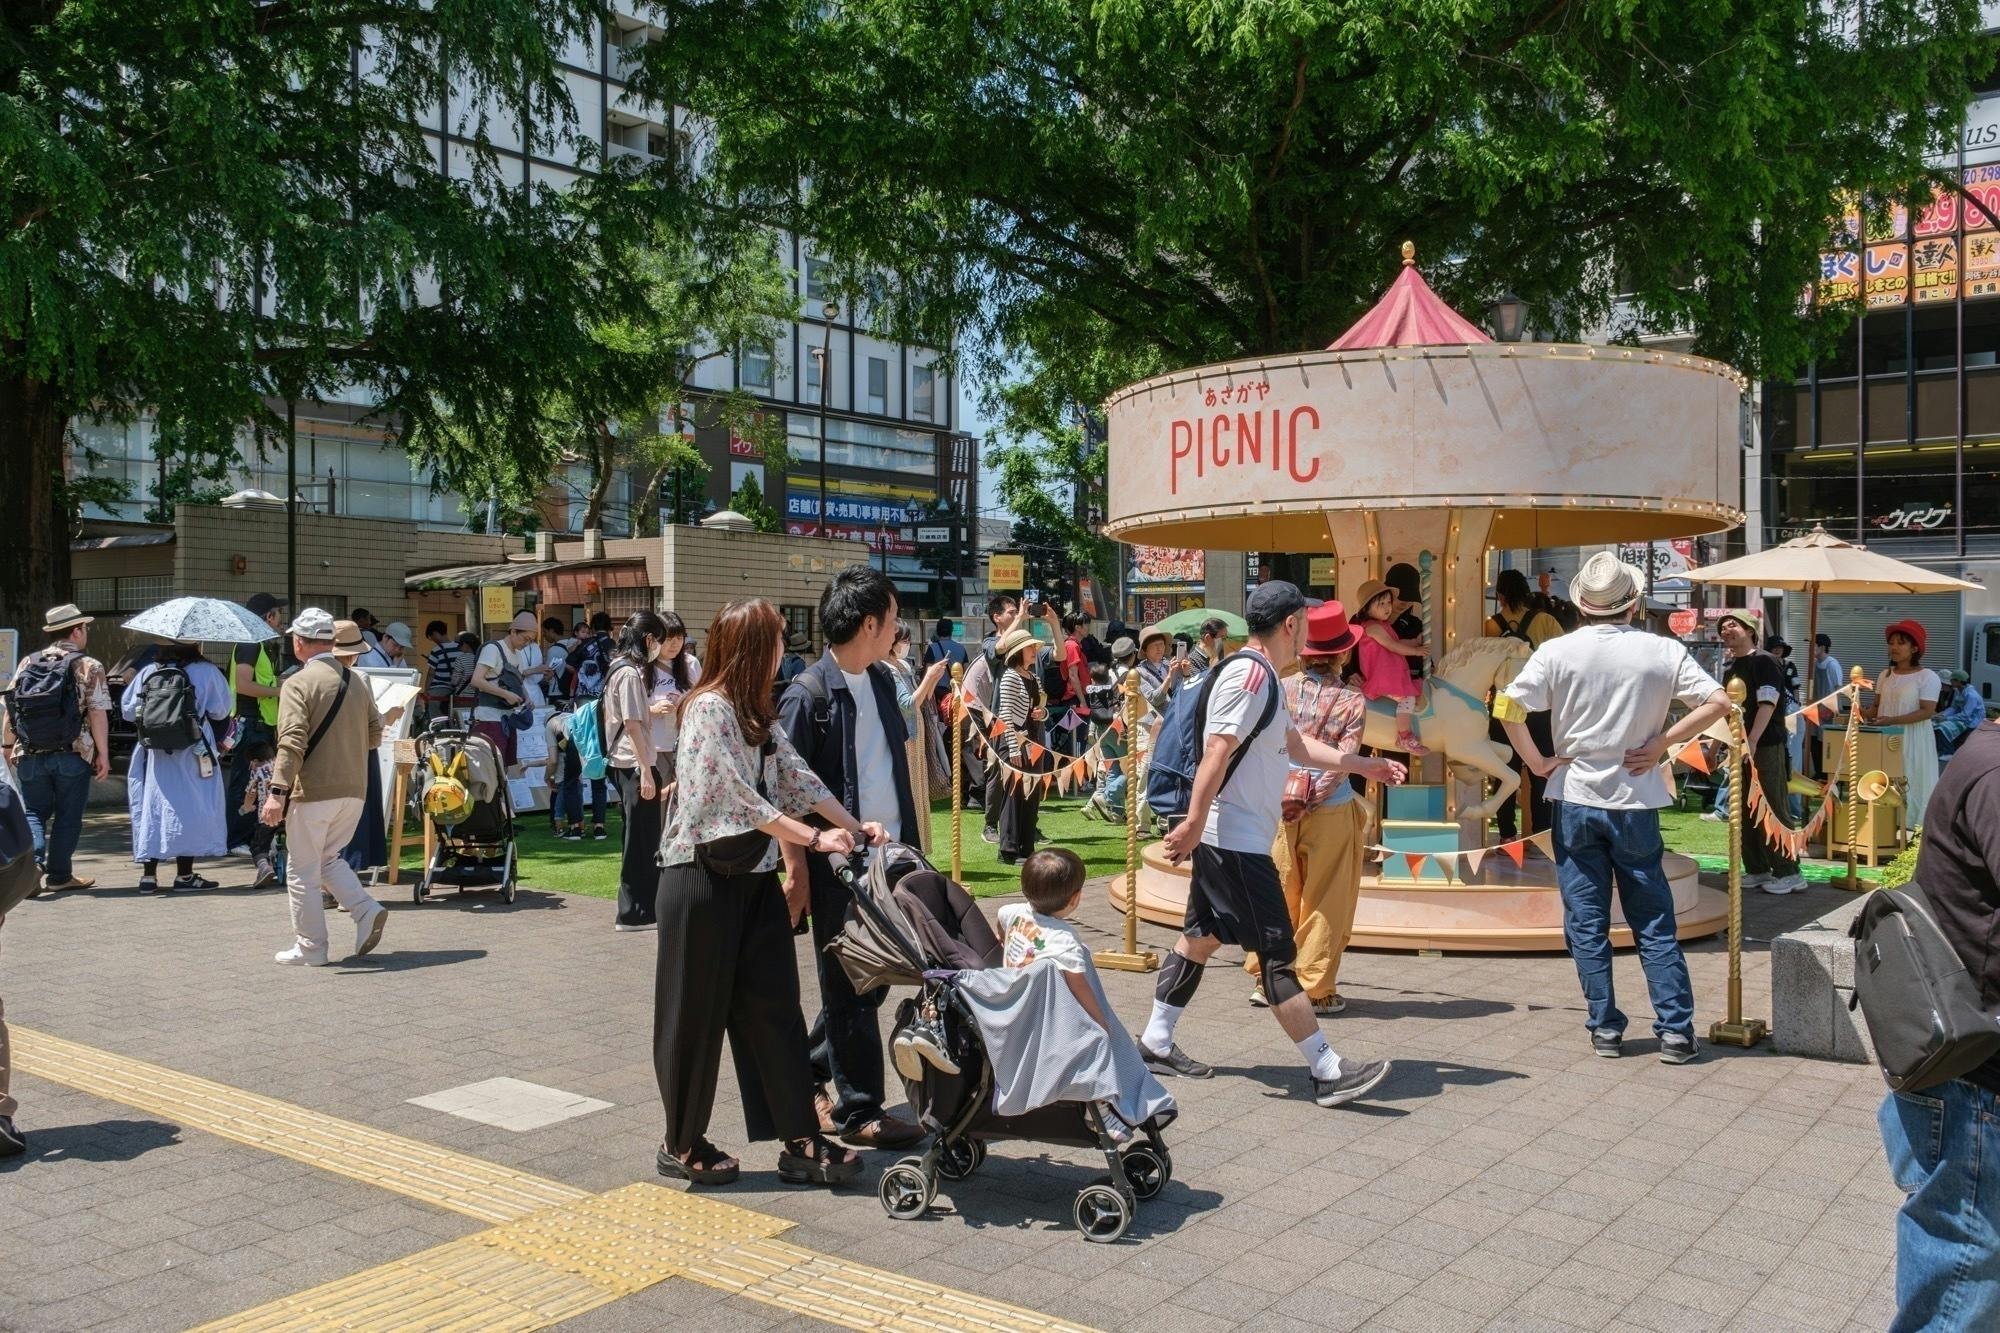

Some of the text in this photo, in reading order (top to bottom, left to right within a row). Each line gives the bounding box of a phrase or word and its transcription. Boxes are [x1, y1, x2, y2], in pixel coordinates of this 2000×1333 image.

[1205, 381, 1270, 407] あさがや
[1171, 405, 1320, 495] PICNIC
